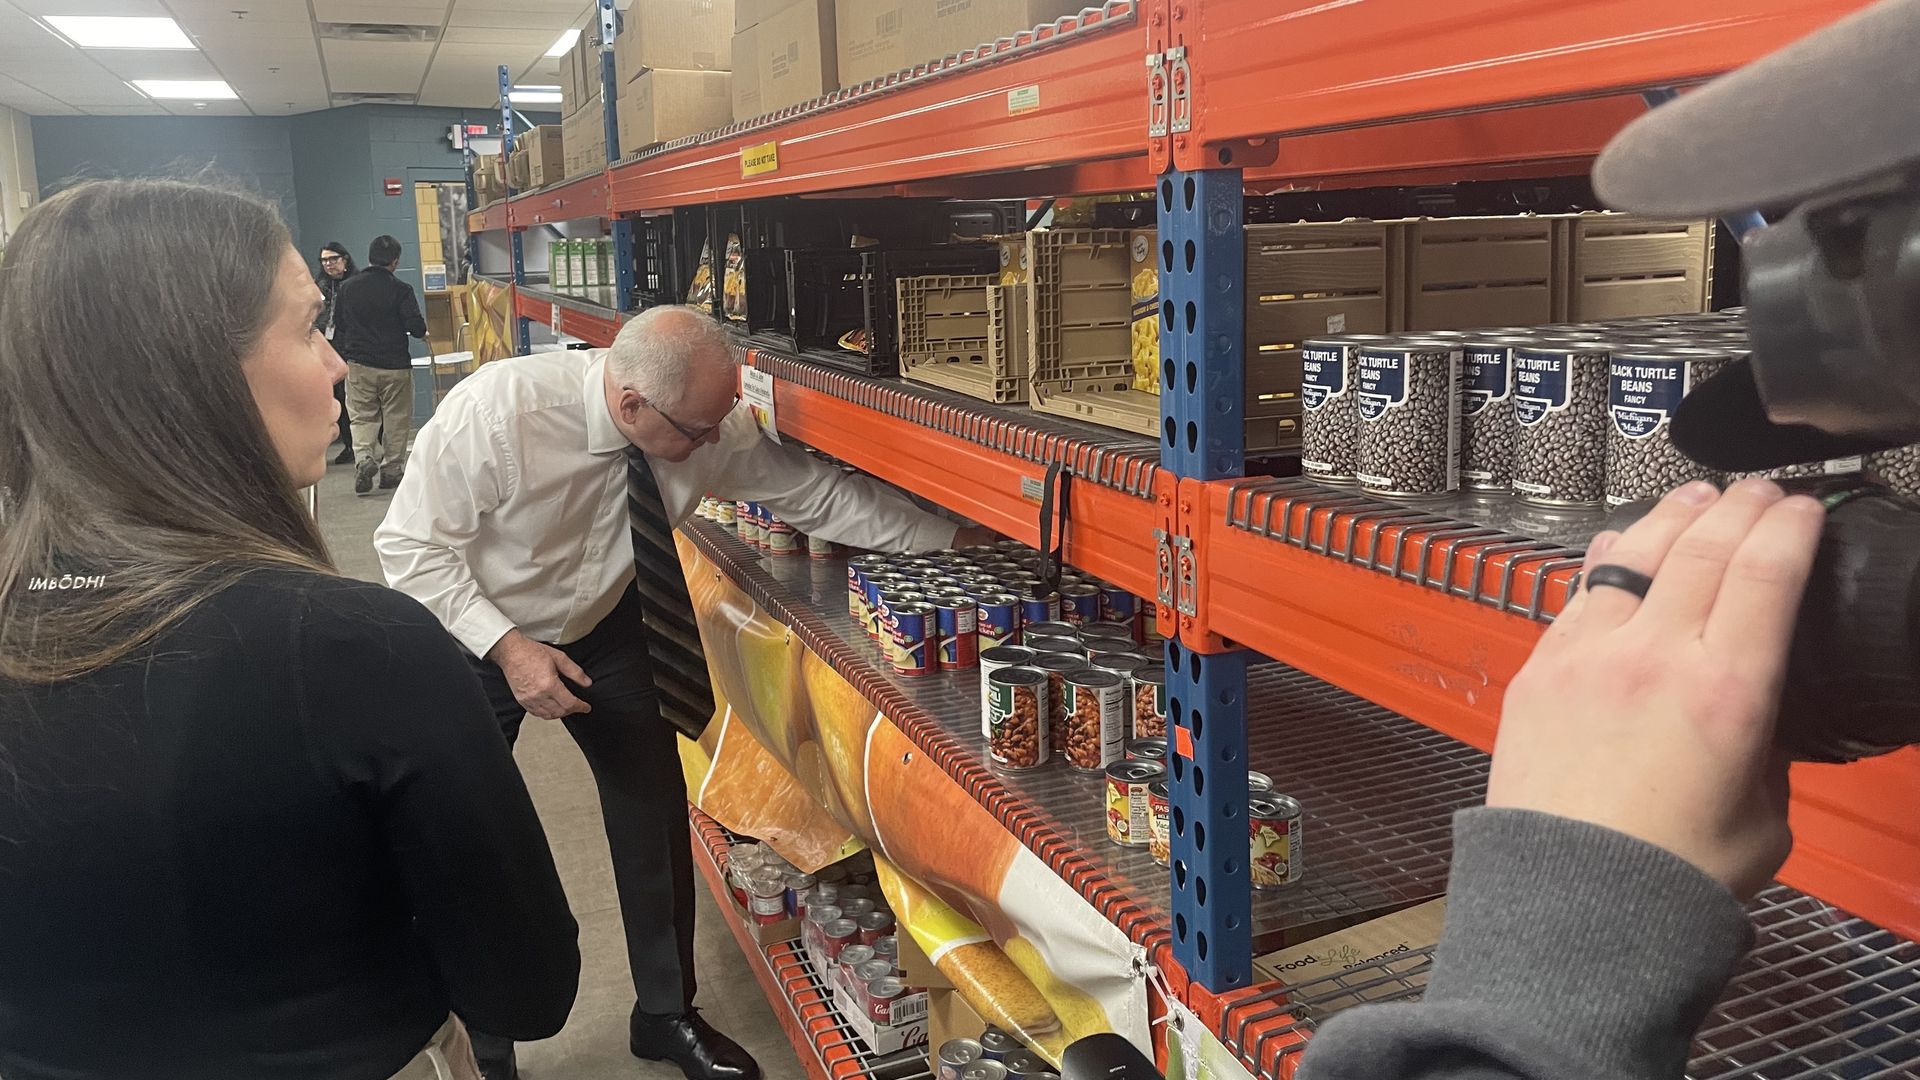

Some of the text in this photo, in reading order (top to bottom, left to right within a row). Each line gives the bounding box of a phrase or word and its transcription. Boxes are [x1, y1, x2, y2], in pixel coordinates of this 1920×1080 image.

[1310, 350, 1337, 361] TURTLE
[1466, 353, 1501, 364] TURTLE
[1304, 361, 1321, 372] BEANS
[1368, 357, 1398, 369] TURTLE
[1527, 359, 1560, 372] TURTLE
[1361, 369, 1381, 380] BEANS
[1518, 371, 1540, 383] BEANS
[1611, 364, 1677, 379] BLACK TURTLE
[1621, 380, 1653, 393] BEANS
[1623, 394, 1647, 405] FANCY
[1616, 411, 1653, 425] Michigan
[1620, 421, 1645, 432] Made
[1273, 954, 1318, 974] Food
